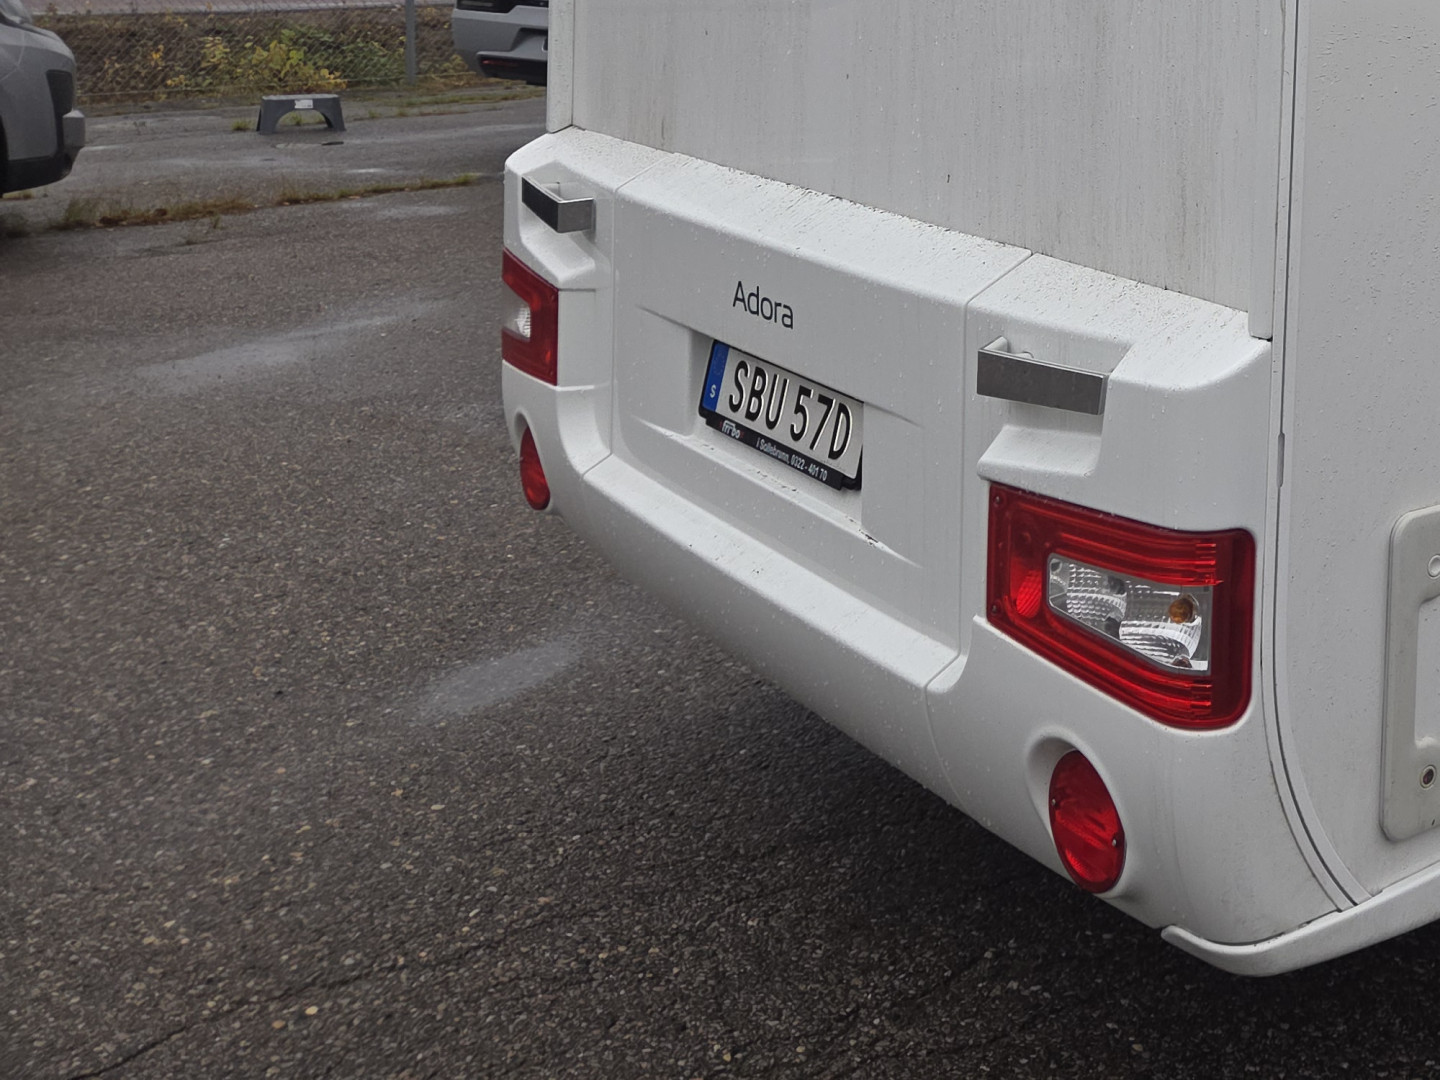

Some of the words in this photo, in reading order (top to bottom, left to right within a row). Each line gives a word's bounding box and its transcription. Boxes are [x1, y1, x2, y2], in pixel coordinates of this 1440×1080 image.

[732, 281, 794, 329] Adora
[709, 384, 717, 399] S
[729, 360, 790, 430] SBU
[790, 385, 853, 460] 57D
[790, 454, 806, 470] 0322
[819, 468, 828, 481] 70
